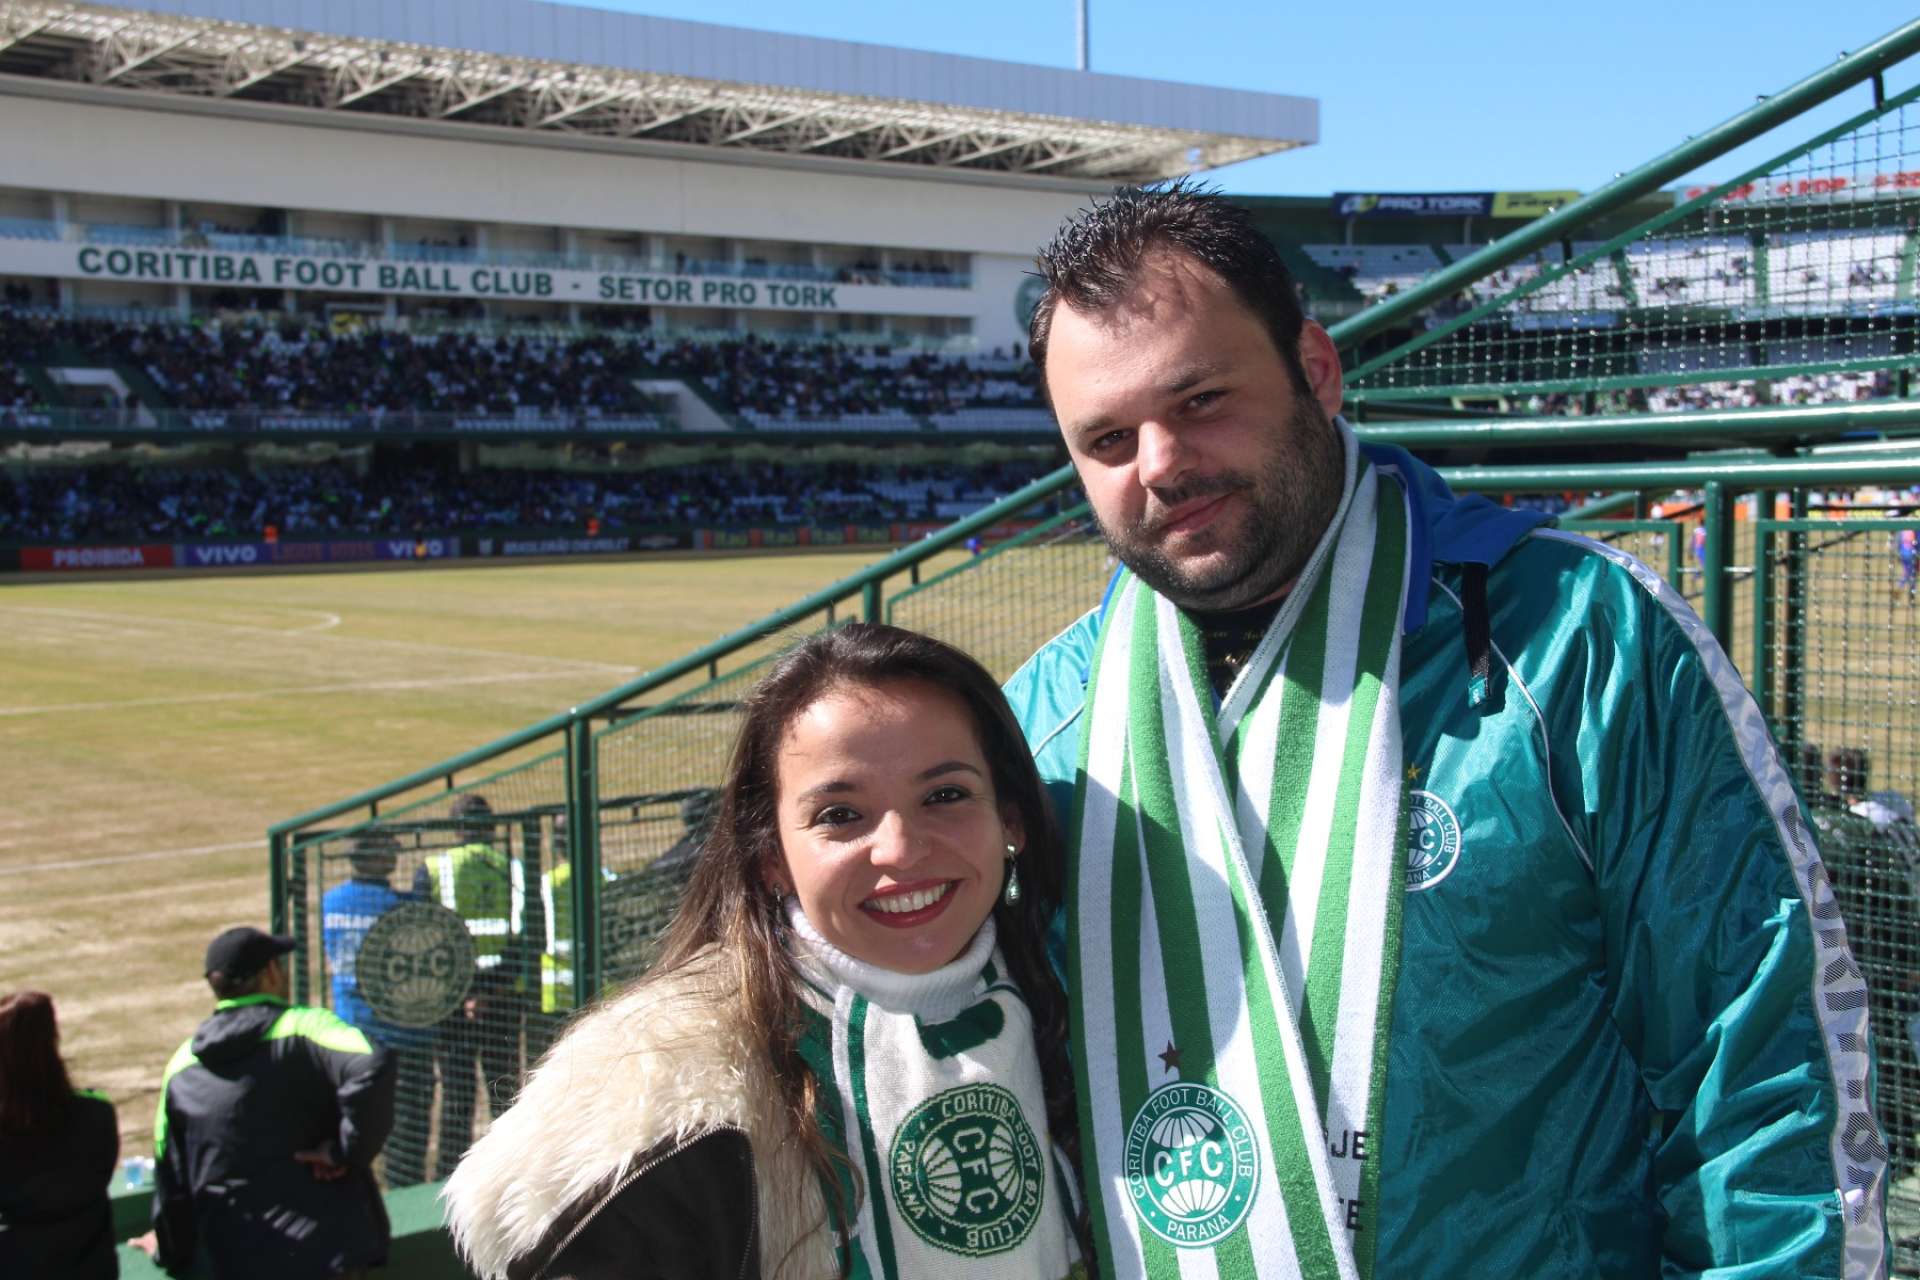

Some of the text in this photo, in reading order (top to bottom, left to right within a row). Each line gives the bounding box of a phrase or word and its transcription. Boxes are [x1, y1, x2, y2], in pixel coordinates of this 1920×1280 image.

[1377, 195, 1482, 209] PRO TORK
[78, 247, 262, 283] CORITIBA
[274, 259, 365, 288] FOOT
[379, 264, 460, 291] BALL
[470, 269, 553, 296] CLUB
[599, 275, 693, 301] SETOR
[703, 279, 757, 304] PRO
[766, 284, 838, 307] TORK
[53, 548, 145, 567] PROIBIDA
[389, 539, 443, 557] VIO
[1423, 798, 1457, 854] BALL CLUB
[386, 947, 451, 983] CFC
[1128, 1088, 1253, 1199] CORITIBA FOOT BALL CLUB
[1153, 1140, 1225, 1188] CFC
[942, 1092, 1039, 1248] CORITIBA FOOT BALL CLUB
[952, 1126, 999, 1215] CFC
[1167, 1207, 1232, 1240] PARANÁ
